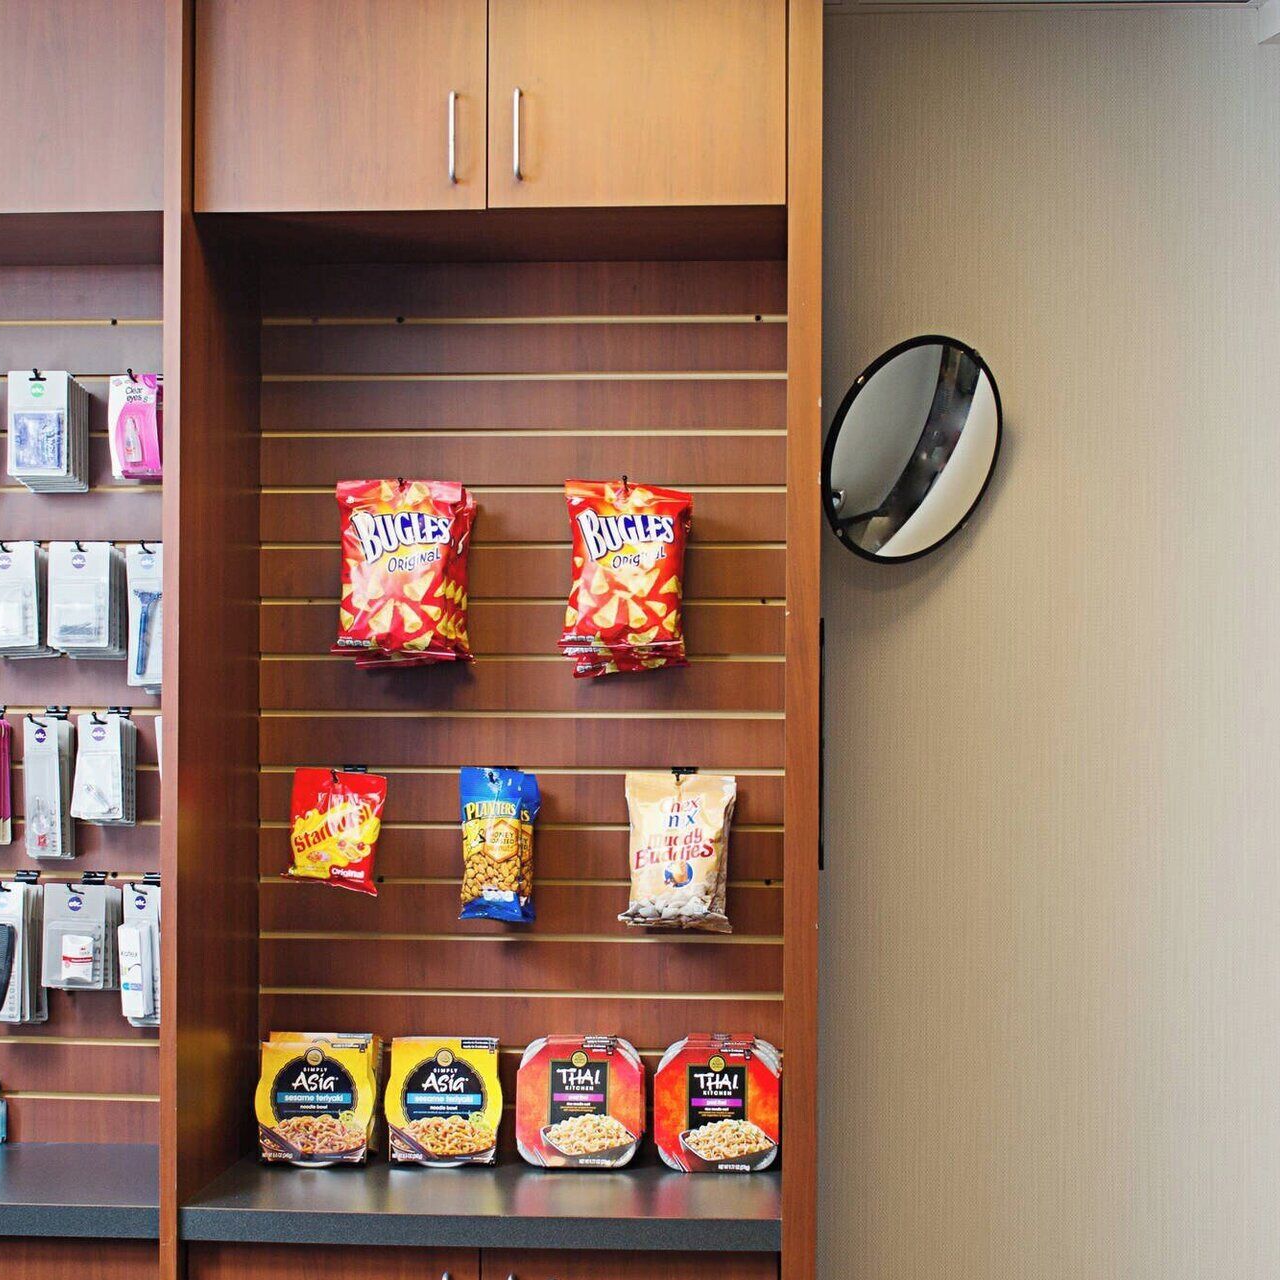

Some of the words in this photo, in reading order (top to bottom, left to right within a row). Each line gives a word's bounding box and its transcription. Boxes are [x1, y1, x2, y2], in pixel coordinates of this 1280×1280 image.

[351, 511, 451, 564] BUGLES
[576, 508, 675, 562] BUGLES
[291, 1071, 337, 1093] Asia
[421, 1072, 467, 1094] Asia
[556, 1067, 601, 1086] THAI
[693, 1072, 739, 1090] THAI
[284, 1094, 315, 1102] sesame
[316, 1092, 344, 1104] teriyaki
[414, 1094, 445, 1103] sesame
